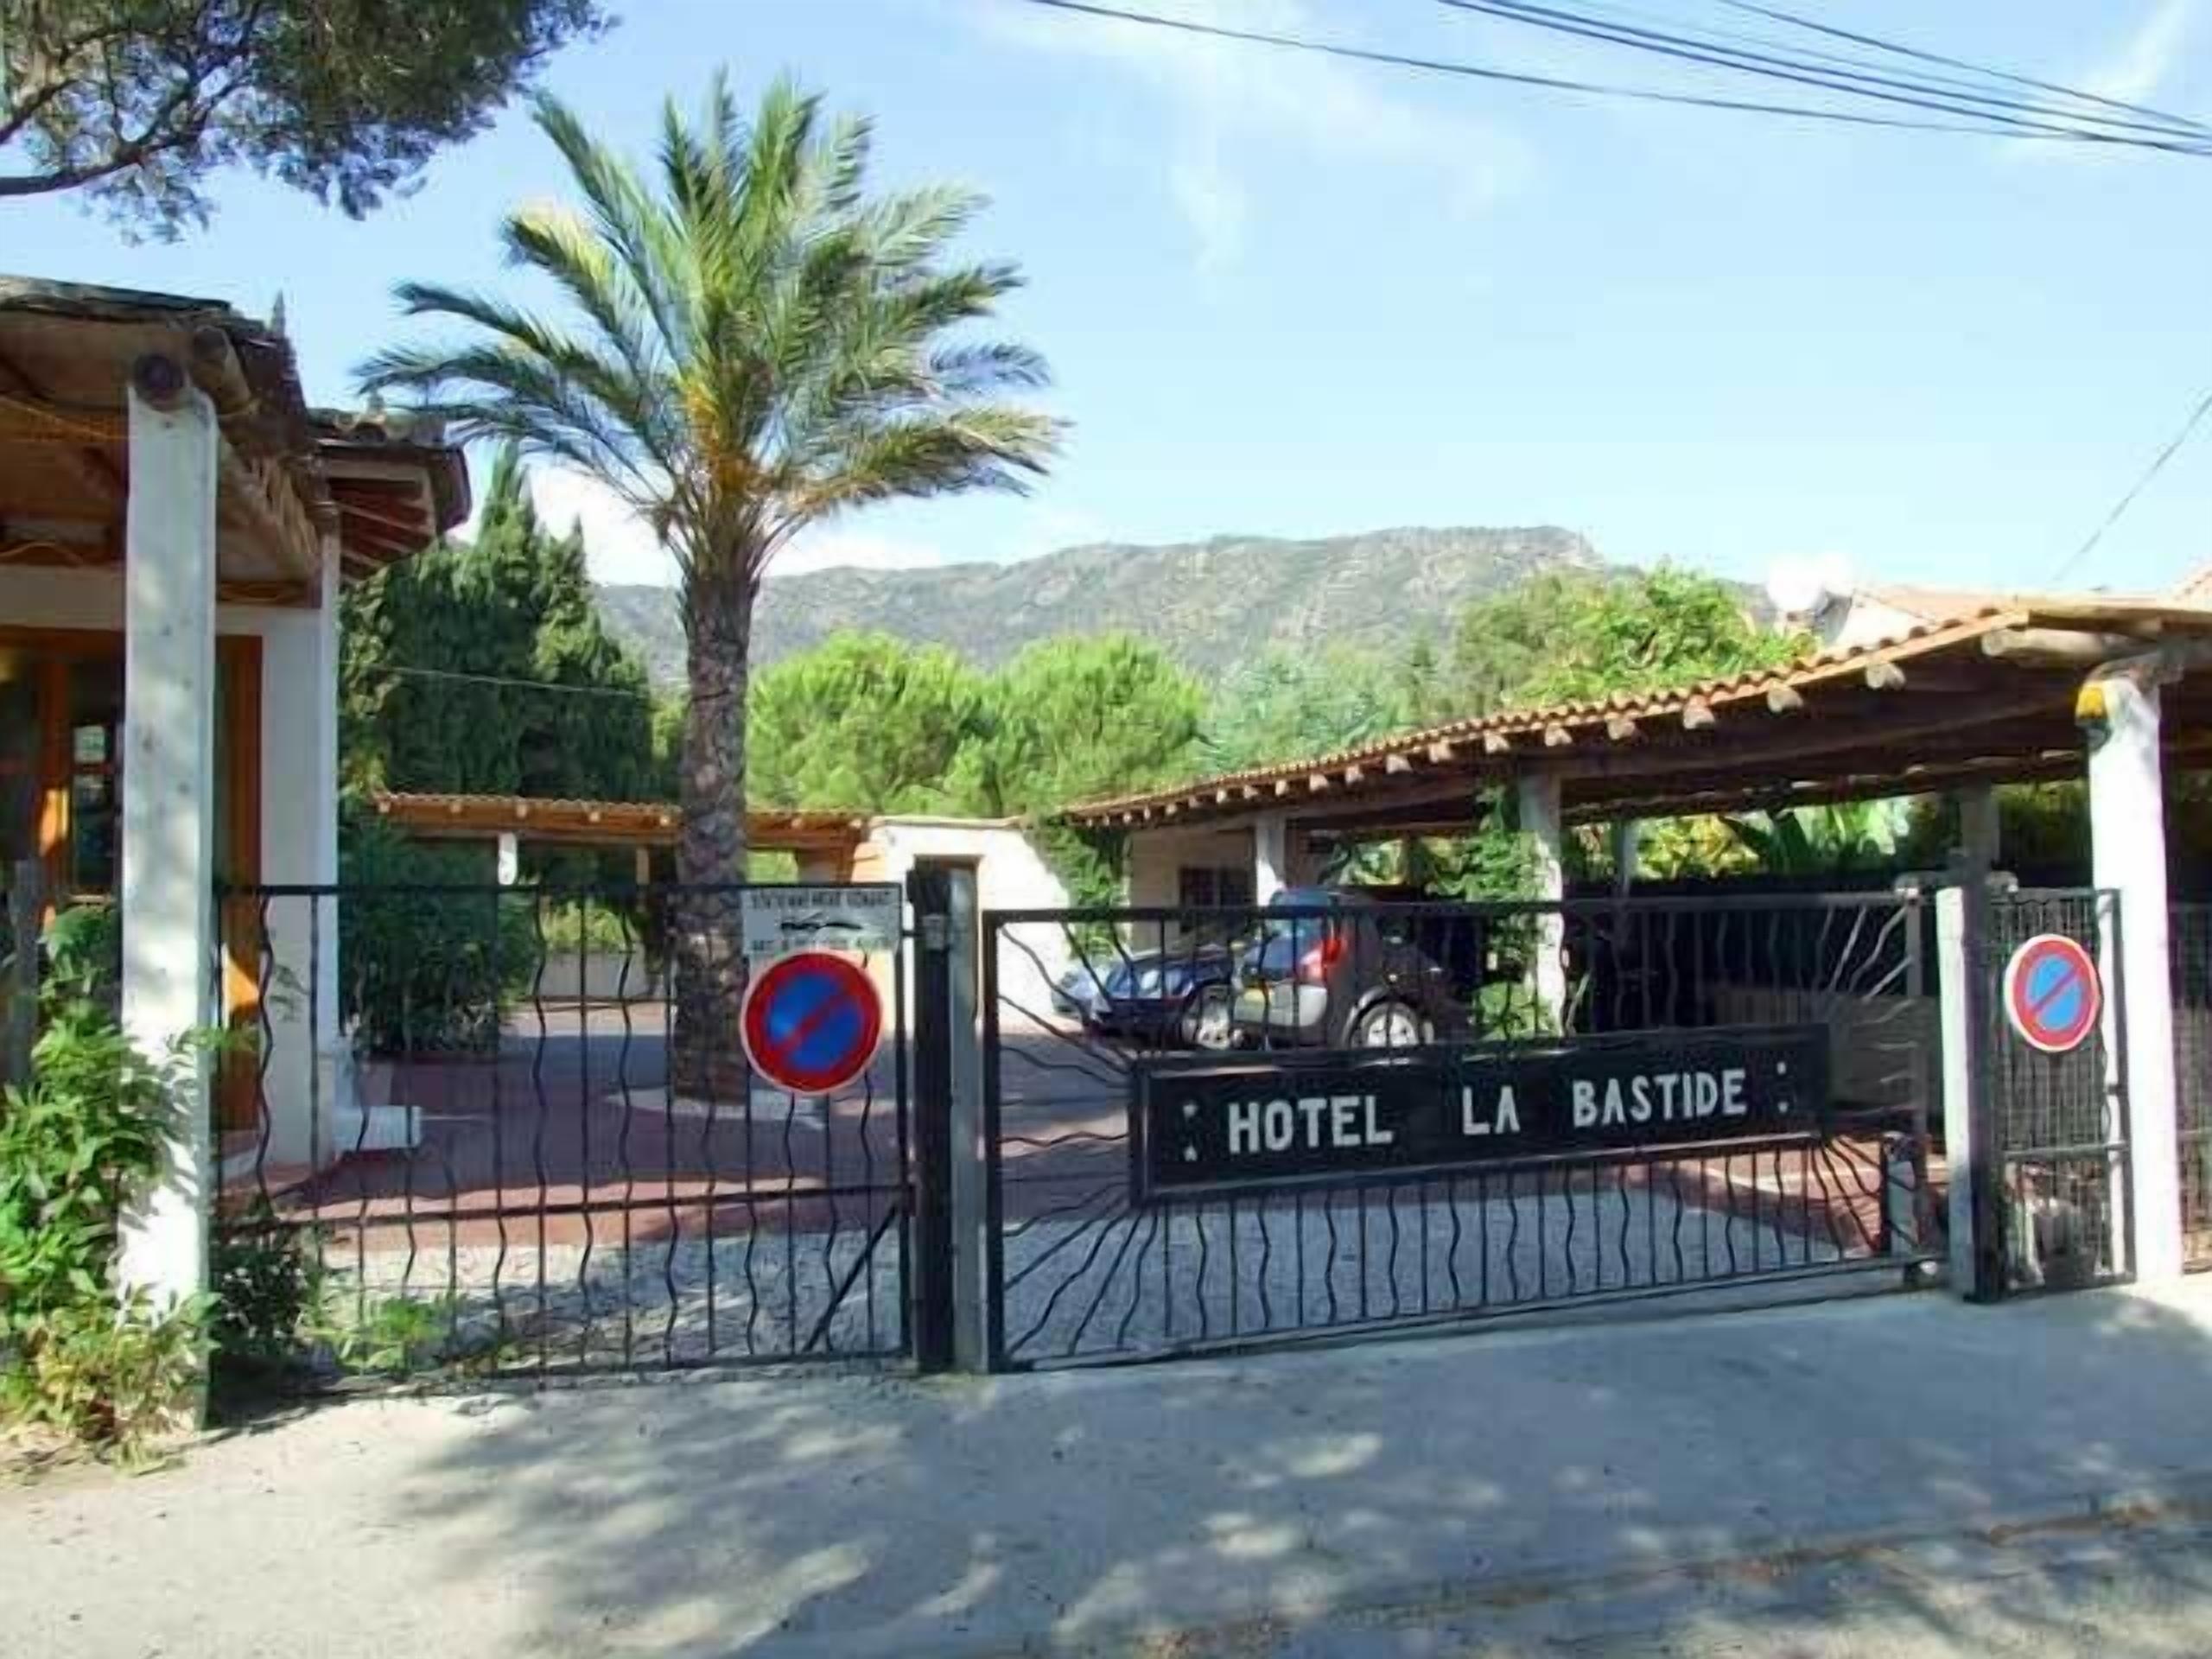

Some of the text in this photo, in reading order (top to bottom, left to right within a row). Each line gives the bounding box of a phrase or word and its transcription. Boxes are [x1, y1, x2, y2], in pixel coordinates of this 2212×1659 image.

[1229, 1069, 1747, 1154] HOTEL LA BASTIDE
